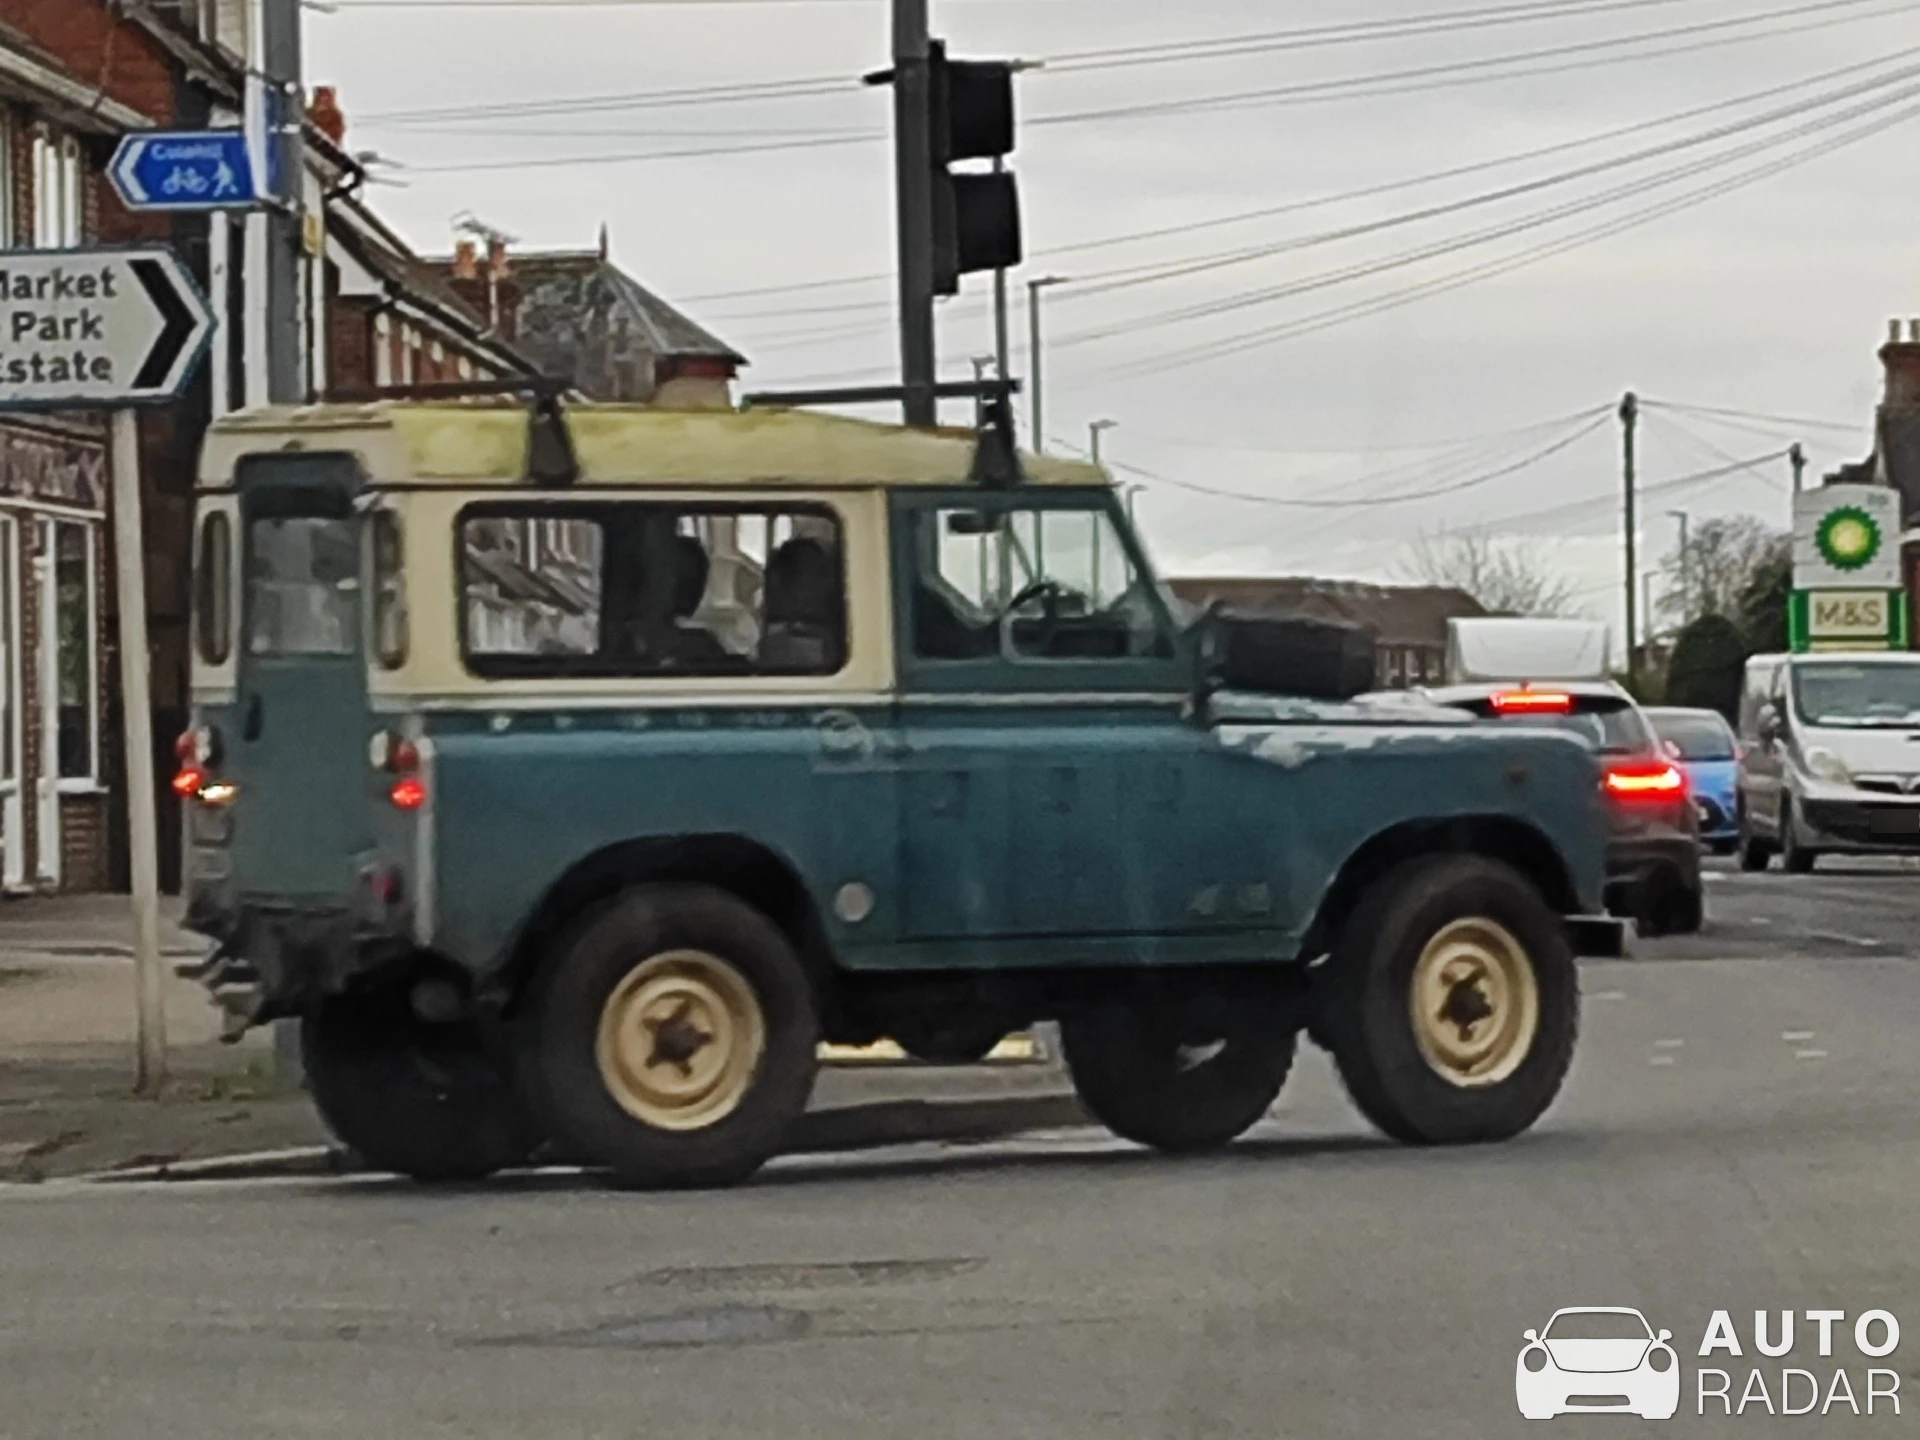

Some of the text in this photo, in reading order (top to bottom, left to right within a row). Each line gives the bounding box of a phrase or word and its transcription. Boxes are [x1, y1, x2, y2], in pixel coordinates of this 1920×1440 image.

[12, 307, 103, 342] Park
[0, 351, 113, 383] state
[1815, 599, 1882, 626] M&S
